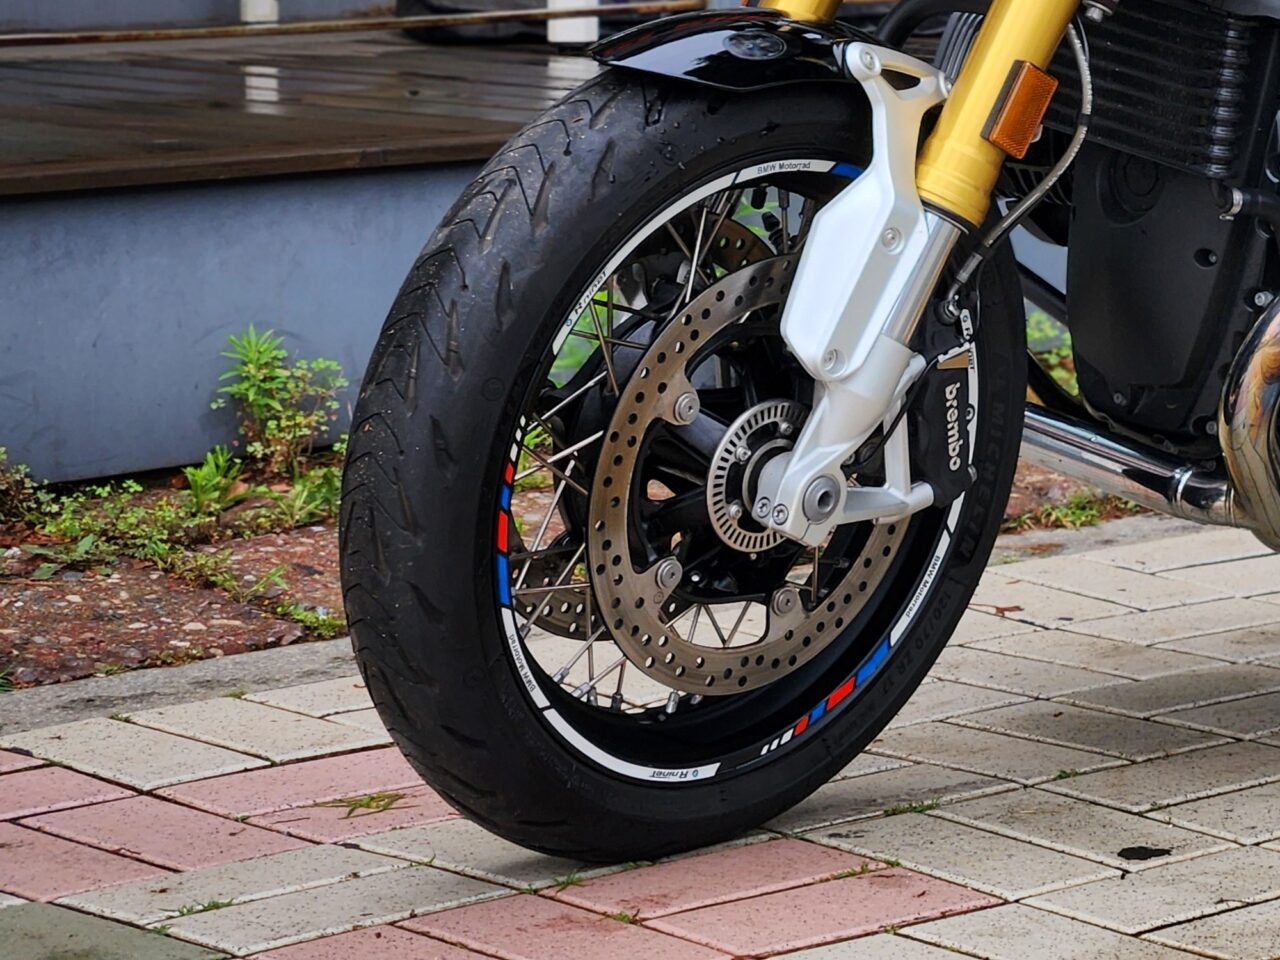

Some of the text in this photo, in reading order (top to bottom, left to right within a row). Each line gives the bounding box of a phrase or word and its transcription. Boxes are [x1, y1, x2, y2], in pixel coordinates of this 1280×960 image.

[757, 161, 811, 175] BMW Motorrad
[944, 382, 964, 471] brembo
[905, 555, 941, 617] BMW Motorrad
